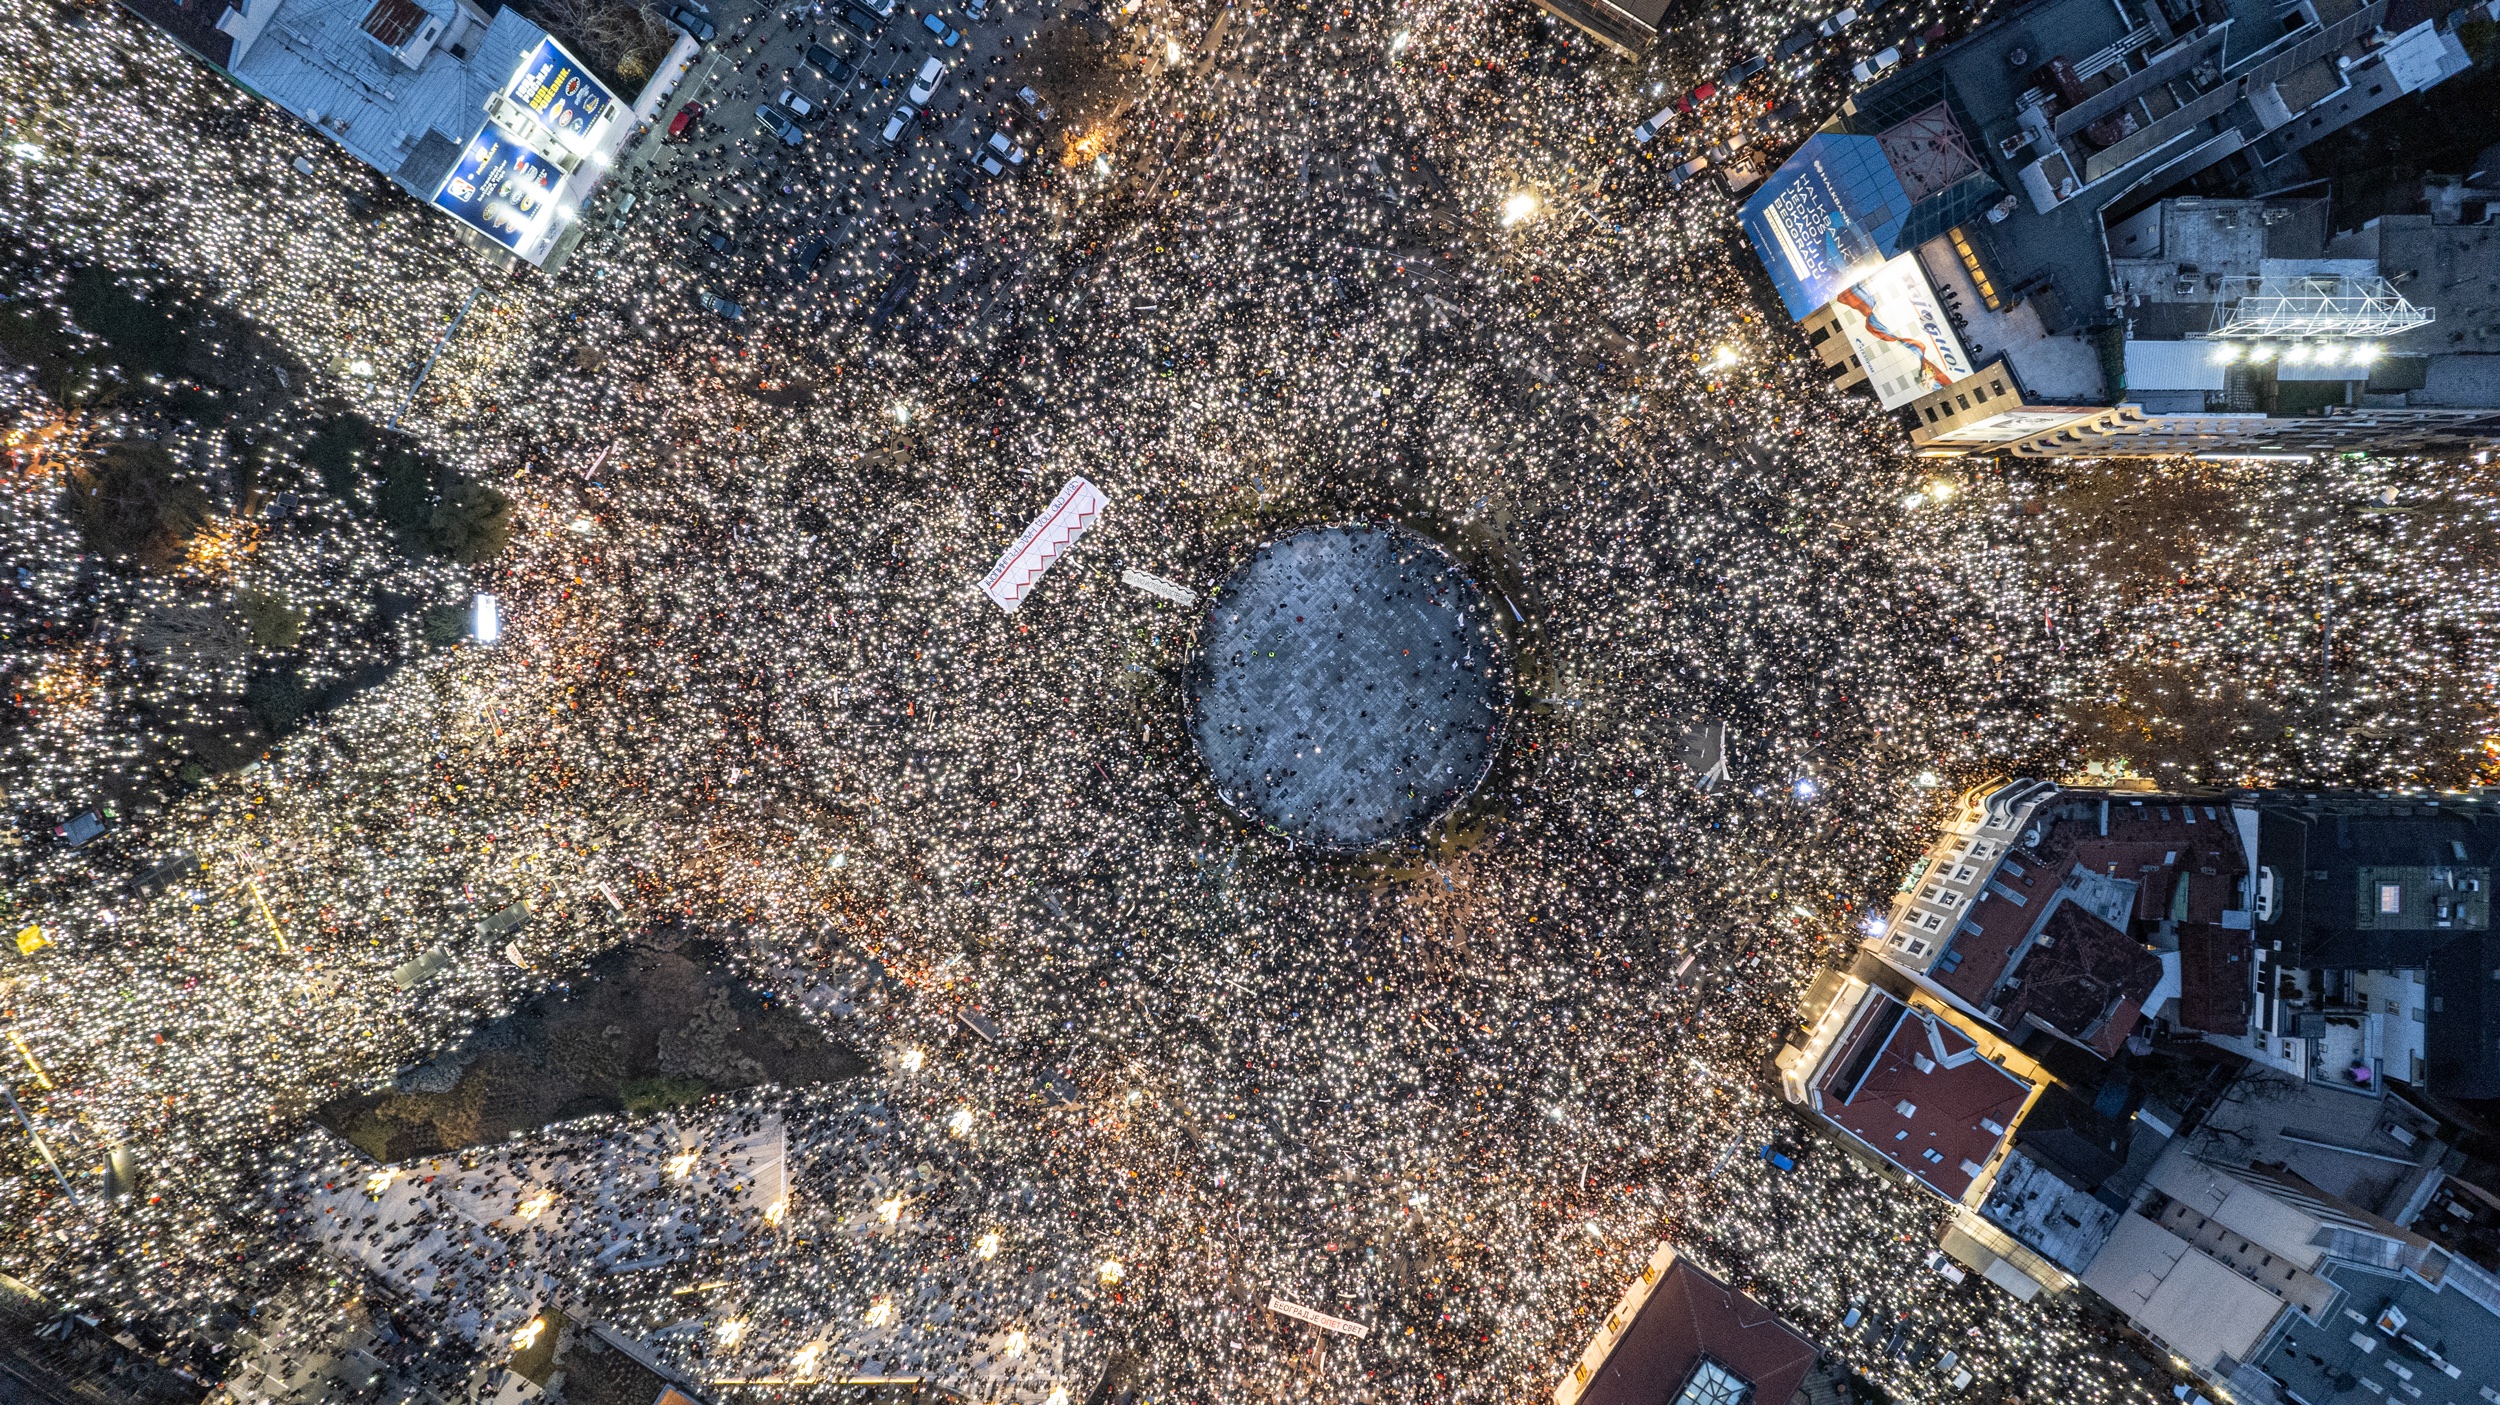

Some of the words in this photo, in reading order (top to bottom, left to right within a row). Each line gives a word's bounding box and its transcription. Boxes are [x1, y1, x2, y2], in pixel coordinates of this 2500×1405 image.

[1786, 188, 1822, 245] JEDNOJ
[1793, 180, 1807, 203] NA
[1807, 207, 1828, 235] JOŠ
[1800, 173, 1850, 260] HALKBANK
[1820, 172, 1851, 226] HALKBANK
[1774, 198, 1822, 280] BEOGRADU
[1780, 192, 1820, 259] LOKACIJI
[1817, 261, 1828, 273] U
[1901, 273, 1966, 374] аједно!
[1051, 497, 1066, 513] СМО
[1065, 480, 1079, 496] СВИ
[1035, 512, 1052, 528] ПОД
[1134, 576, 1145, 586] СМО
[1273, 1301, 1309, 1319] БЕОГРАД
[1320, 1317, 1342, 1329] ОПЕТ
[1342, 1323, 1362, 1334] СВЕТ
